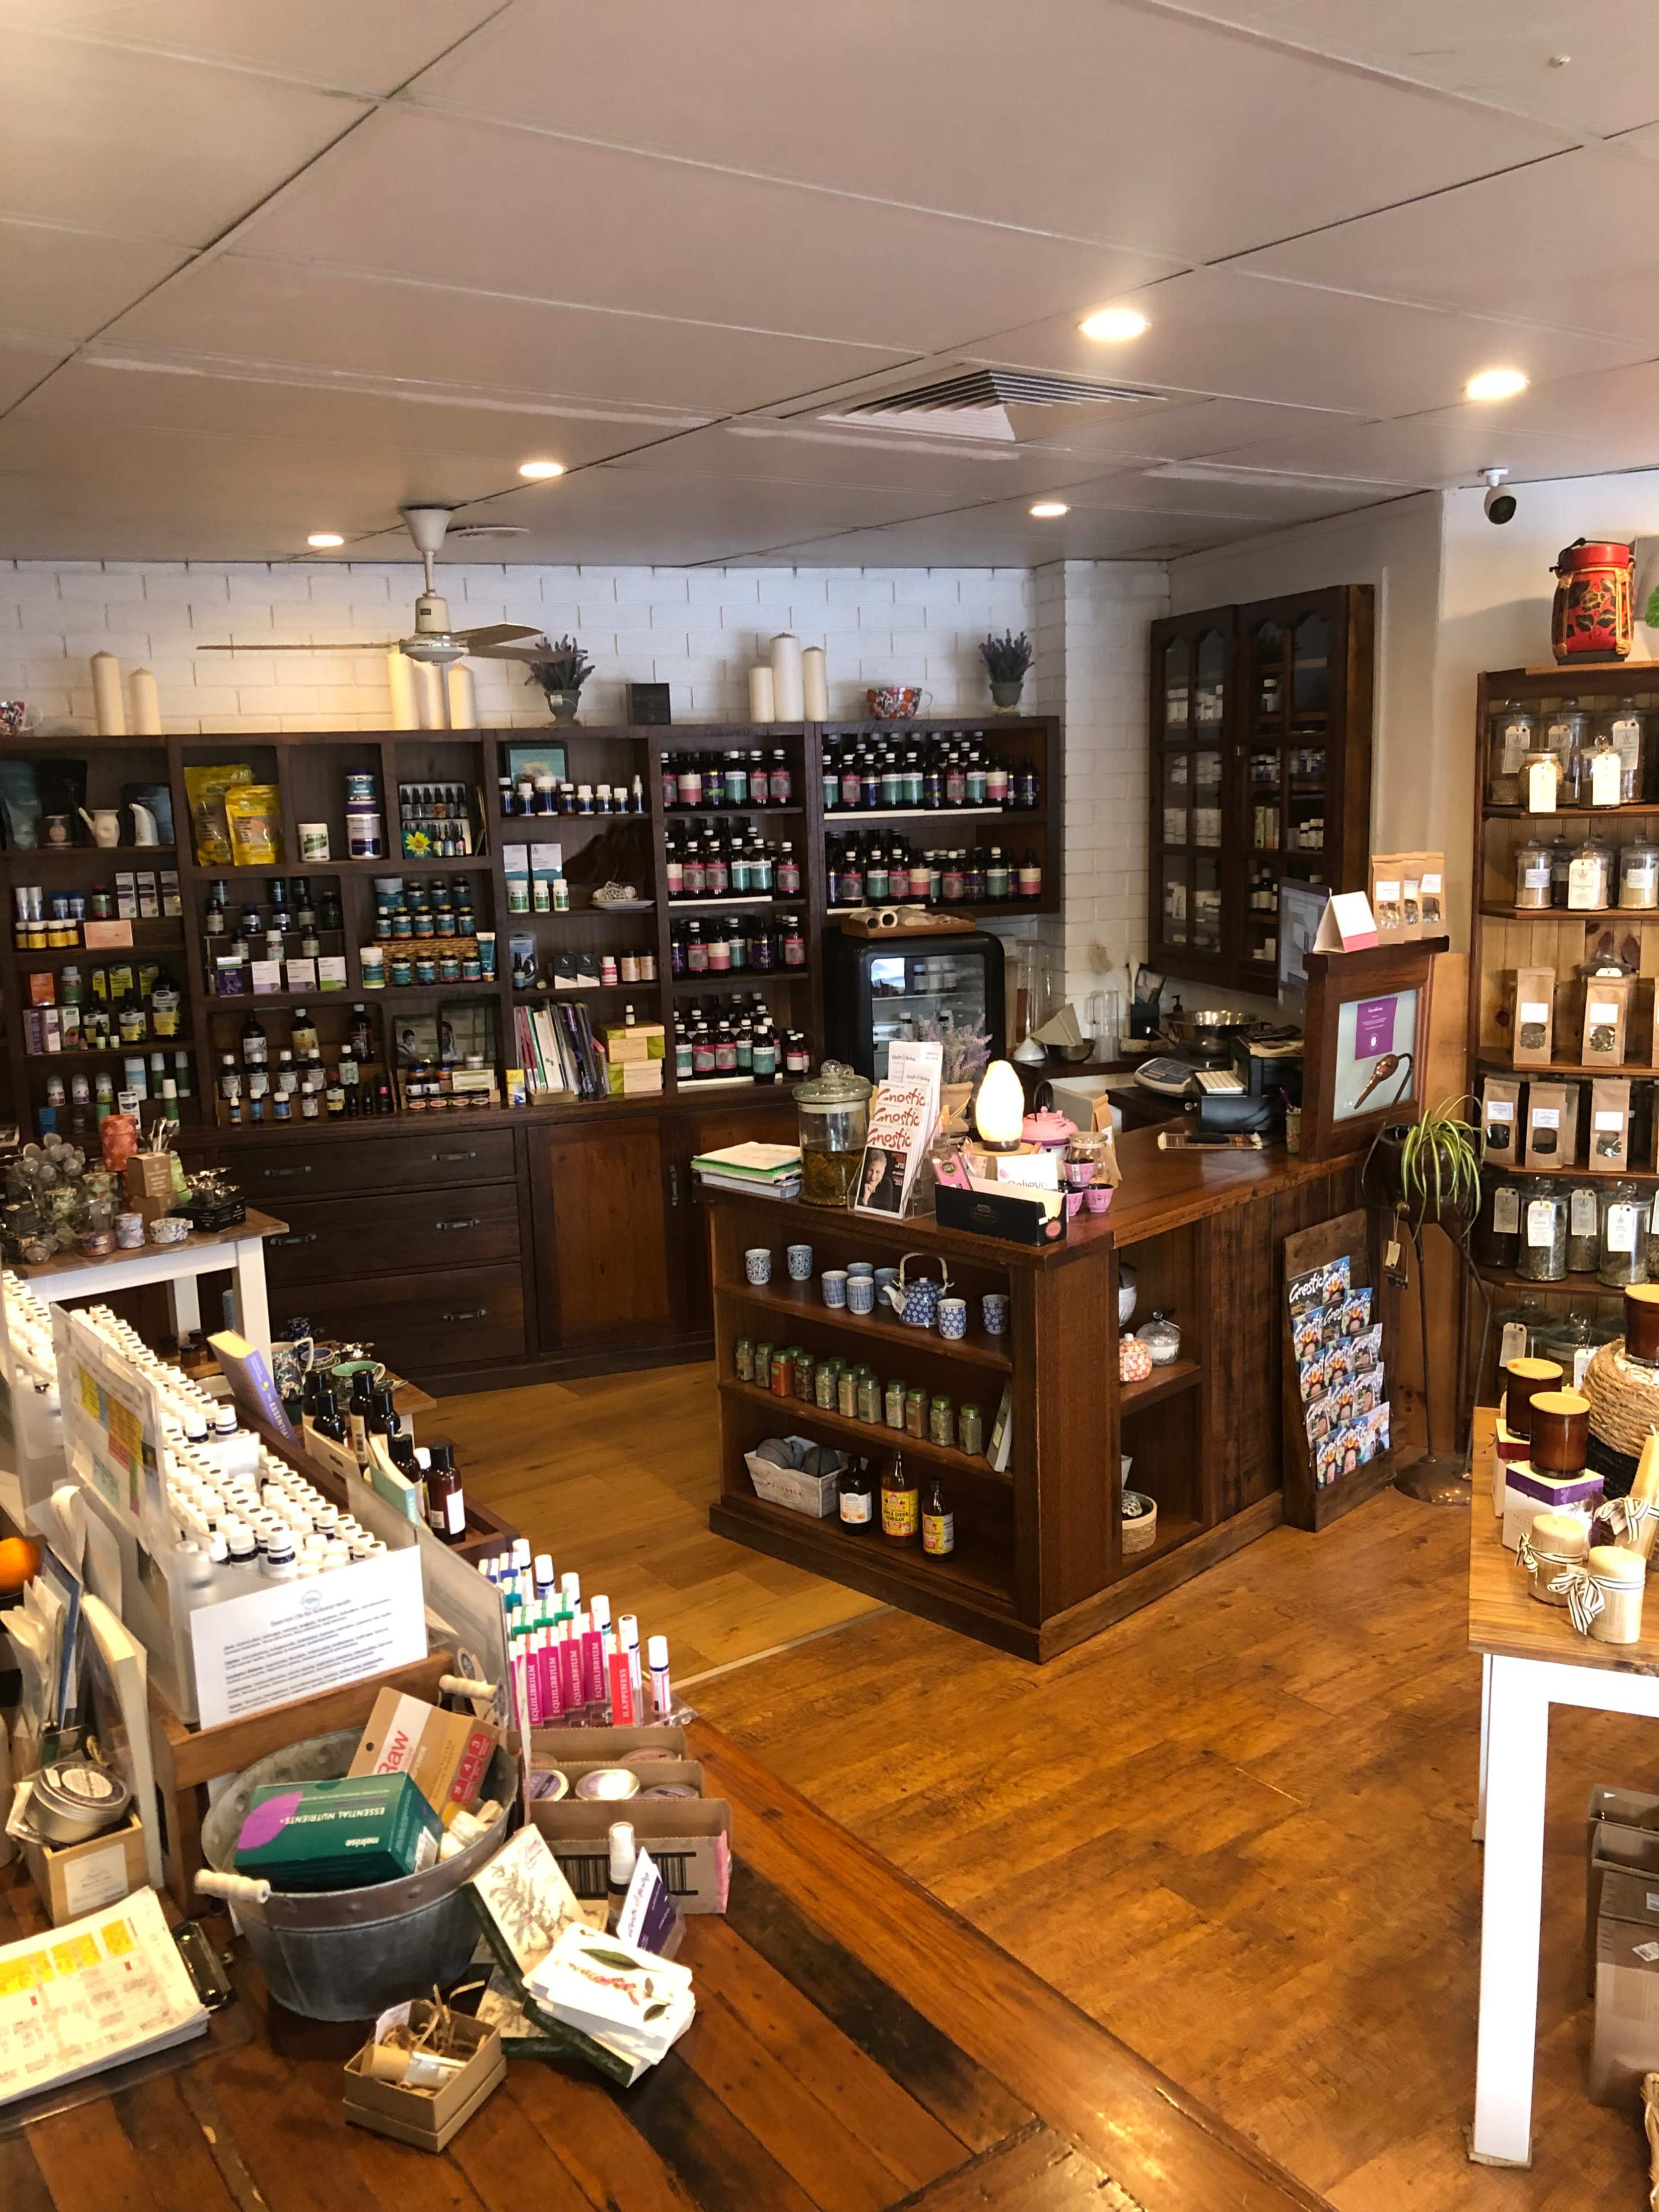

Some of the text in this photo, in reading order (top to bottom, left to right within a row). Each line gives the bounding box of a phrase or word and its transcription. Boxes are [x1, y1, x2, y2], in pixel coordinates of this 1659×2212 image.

[874, 1107, 919, 1126] Gnostic
[878, 1088, 925, 1106] Gnostic
[866, 1128, 912, 1150] Gnostic
[1289, 1272, 1323, 1303] Gnostic
[549, 1657, 560, 1714] EQUILIBRIUM
[570, 1650, 582, 1706] EQUILIBRIUM
[592, 1642, 602, 1698] EQUILIBRIUM
[528, 1665, 539, 1722] EQUILIBRIUM
[619, 1669, 629, 1717] HAPPINESS
[378, 1730, 409, 1773] Raw
[339, 1807, 385, 1819] ESSENTIAL
